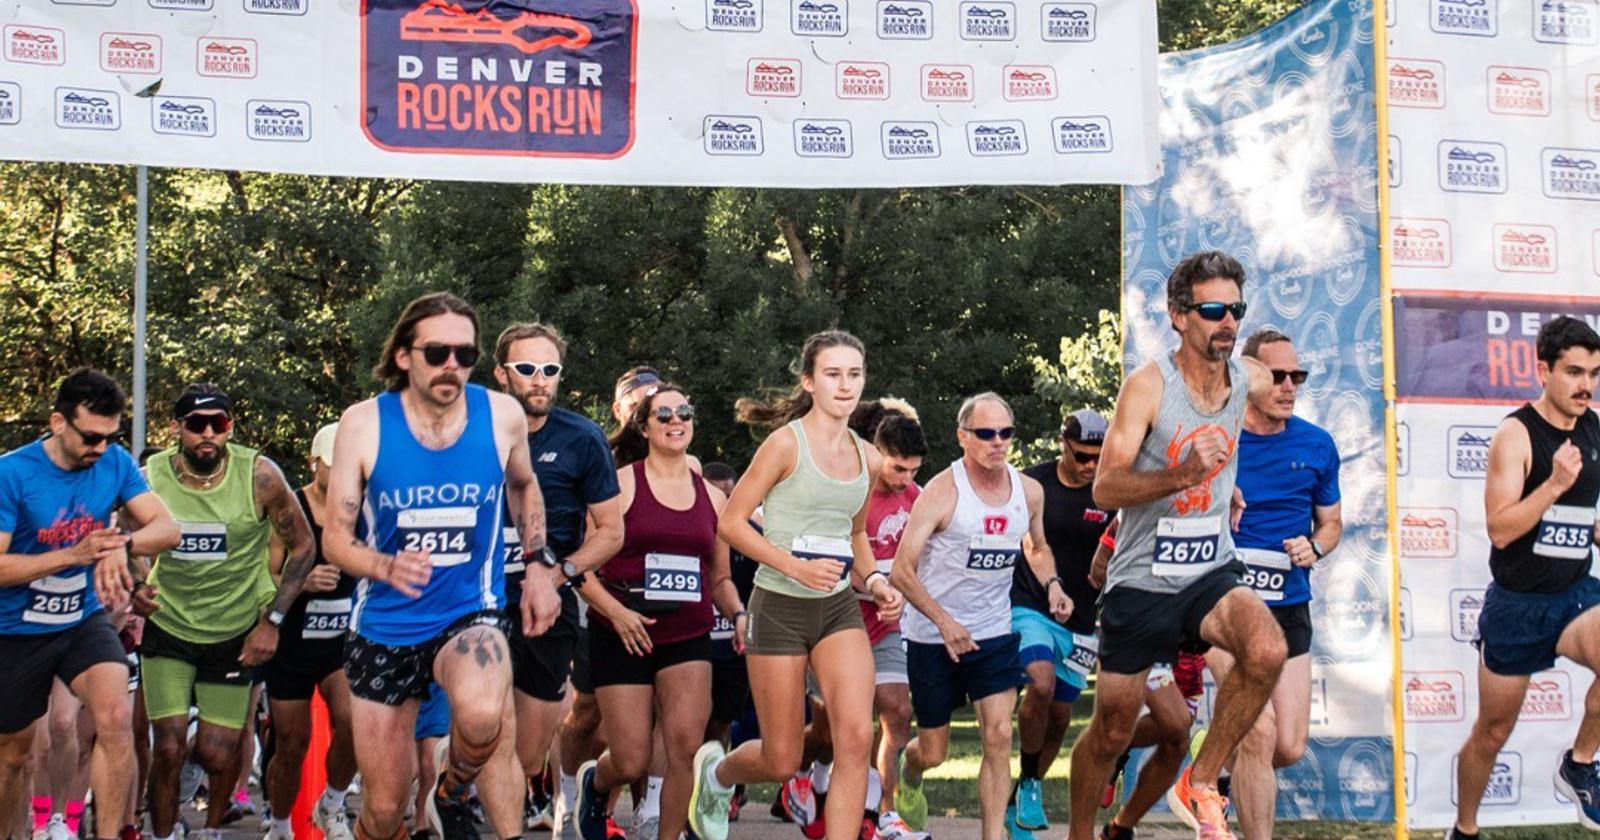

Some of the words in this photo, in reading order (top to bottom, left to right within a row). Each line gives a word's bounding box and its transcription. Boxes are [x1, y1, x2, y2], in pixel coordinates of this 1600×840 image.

[712, 14, 738, 27] ROCKS
[740, 16, 756, 28] RUN
[798, 20, 825, 31] ROCKS
[826, 21, 841, 32] RUN
[1438, 14, 1470, 28] ROCKS
[1471, 16, 1490, 30] RUN
[883, 23, 909, 34] ROCKS
[910, 24, 926, 35] RUN
[967, 24, 992, 36] ROCKS
[994, 24, 1010, 36] RUN
[1049, 26, 1074, 37] ROCKS
[1074, 26, 1090, 38] RUN
[204, 60, 232, 72] ROCKS
[233, 62, 250, 74] RUN
[398, 56, 603, 86] DENVER
[754, 80, 779, 92] ROCKS
[780, 81, 796, 92] RUN
[842, 84, 867, 95] ROCKS
[868, 84, 885, 96] RUN
[397, 82, 521, 132] ROCKS
[528, 86, 602, 136] RUN
[63, 111, 94, 124] ROCKS
[95, 113, 114, 124] RUN
[160, 118, 188, 130] ROCKS
[190, 120, 208, 132] RUN
[255, 125, 284, 136] ROCKS
[284, 126, 304, 138] RUN
[712, 140, 739, 150] ROCKS
[740, 140, 756, 151] RUN
[802, 141, 828, 152] ROCKS
[830, 142, 846, 153] RUN
[889, 144, 916, 155] ROCKS
[917, 144, 934, 155] RUN
[976, 140, 1003, 152] ROCKS
[1004, 139, 1021, 151] RUN
[1062, 138, 1088, 150] ROCKS
[1090, 138, 1106, 148] RUN
[1448, 171, 1478, 185] ROCKS
[1480, 173, 1500, 187] RUN
[1551, 179, 1580, 192] ROCKS
[1582, 181, 1600, 194] RUN
[378, 483, 496, 510] AURORA
[404, 532, 466, 552] 2614
[1541, 526, 1590, 547] 2635
[1158, 541, 1214, 562] 2670
[970, 554, 1016, 569] 2684
[649, 572, 698, 590] 2499
[33, 594, 81, 612] 2615
[306, 614, 349, 630] 2643
